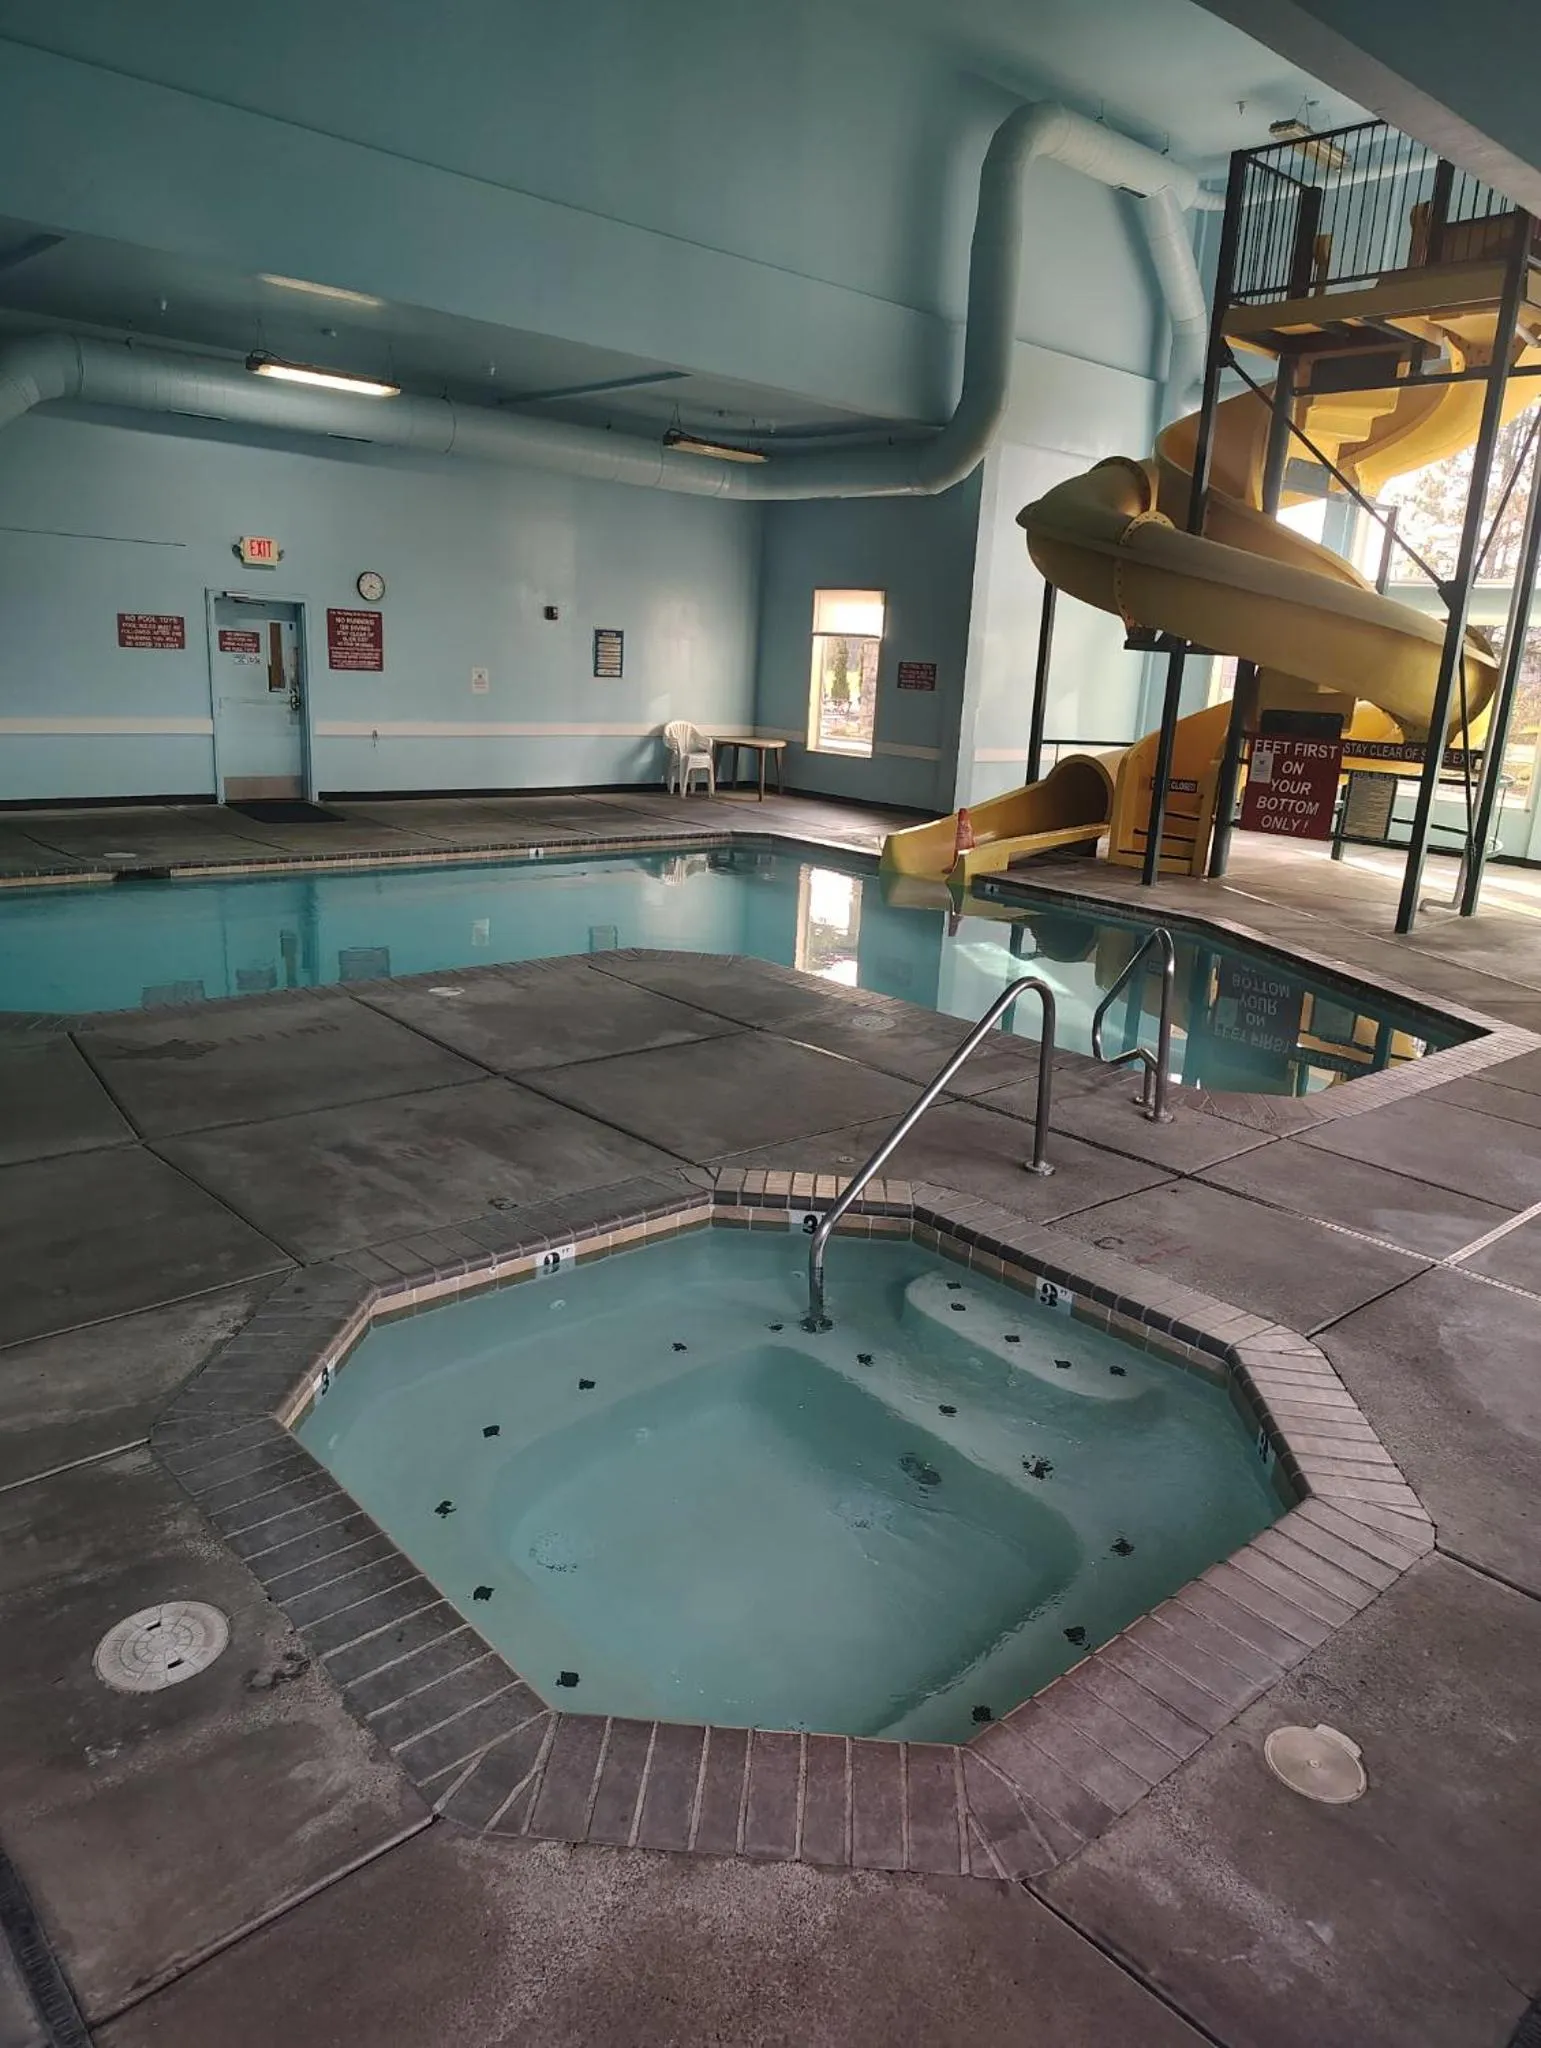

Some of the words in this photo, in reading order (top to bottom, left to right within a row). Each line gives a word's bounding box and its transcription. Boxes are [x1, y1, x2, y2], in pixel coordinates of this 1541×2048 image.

[249, 540, 272, 558] EXIT
[1254, 739, 1291, 755] FEET
[1294, 742, 1338, 760] FIRST
[1343, 742, 1368, 756] STAY
[1370, 745, 1401, 758] CLEAR
[1405, 748, 1417, 759] OF
[1281, 760, 1305, 775] ON
[1271, 778, 1312, 795] YOUR
[1256, 796, 1320, 816] BOTTOM
